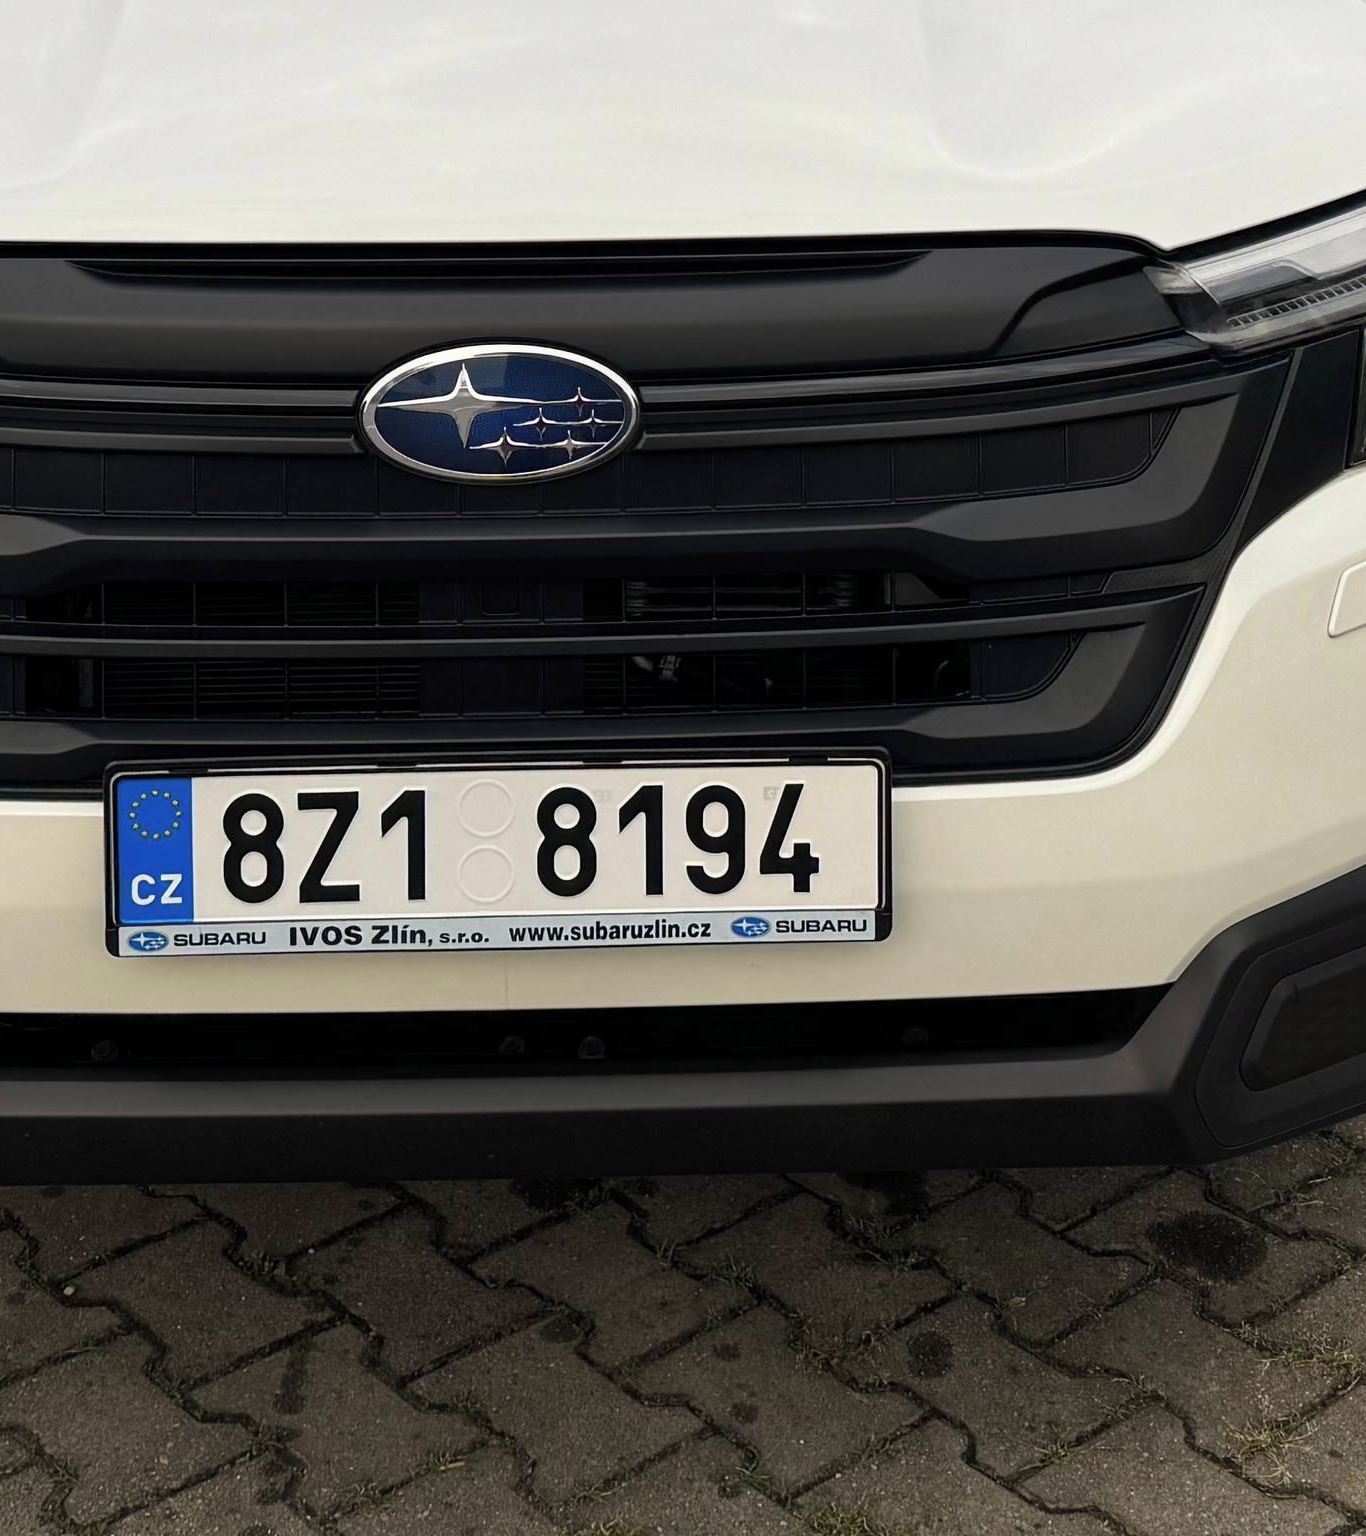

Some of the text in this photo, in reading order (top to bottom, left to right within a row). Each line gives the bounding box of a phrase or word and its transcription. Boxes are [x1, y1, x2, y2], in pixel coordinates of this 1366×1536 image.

[222, 783, 820, 904] 8Z1 8194
[131, 873, 183, 905] CZ
[173, 918, 868, 947] SUBARU IVOS Zlín, s.r.o. www.subaruzlin.cz SUBARU
